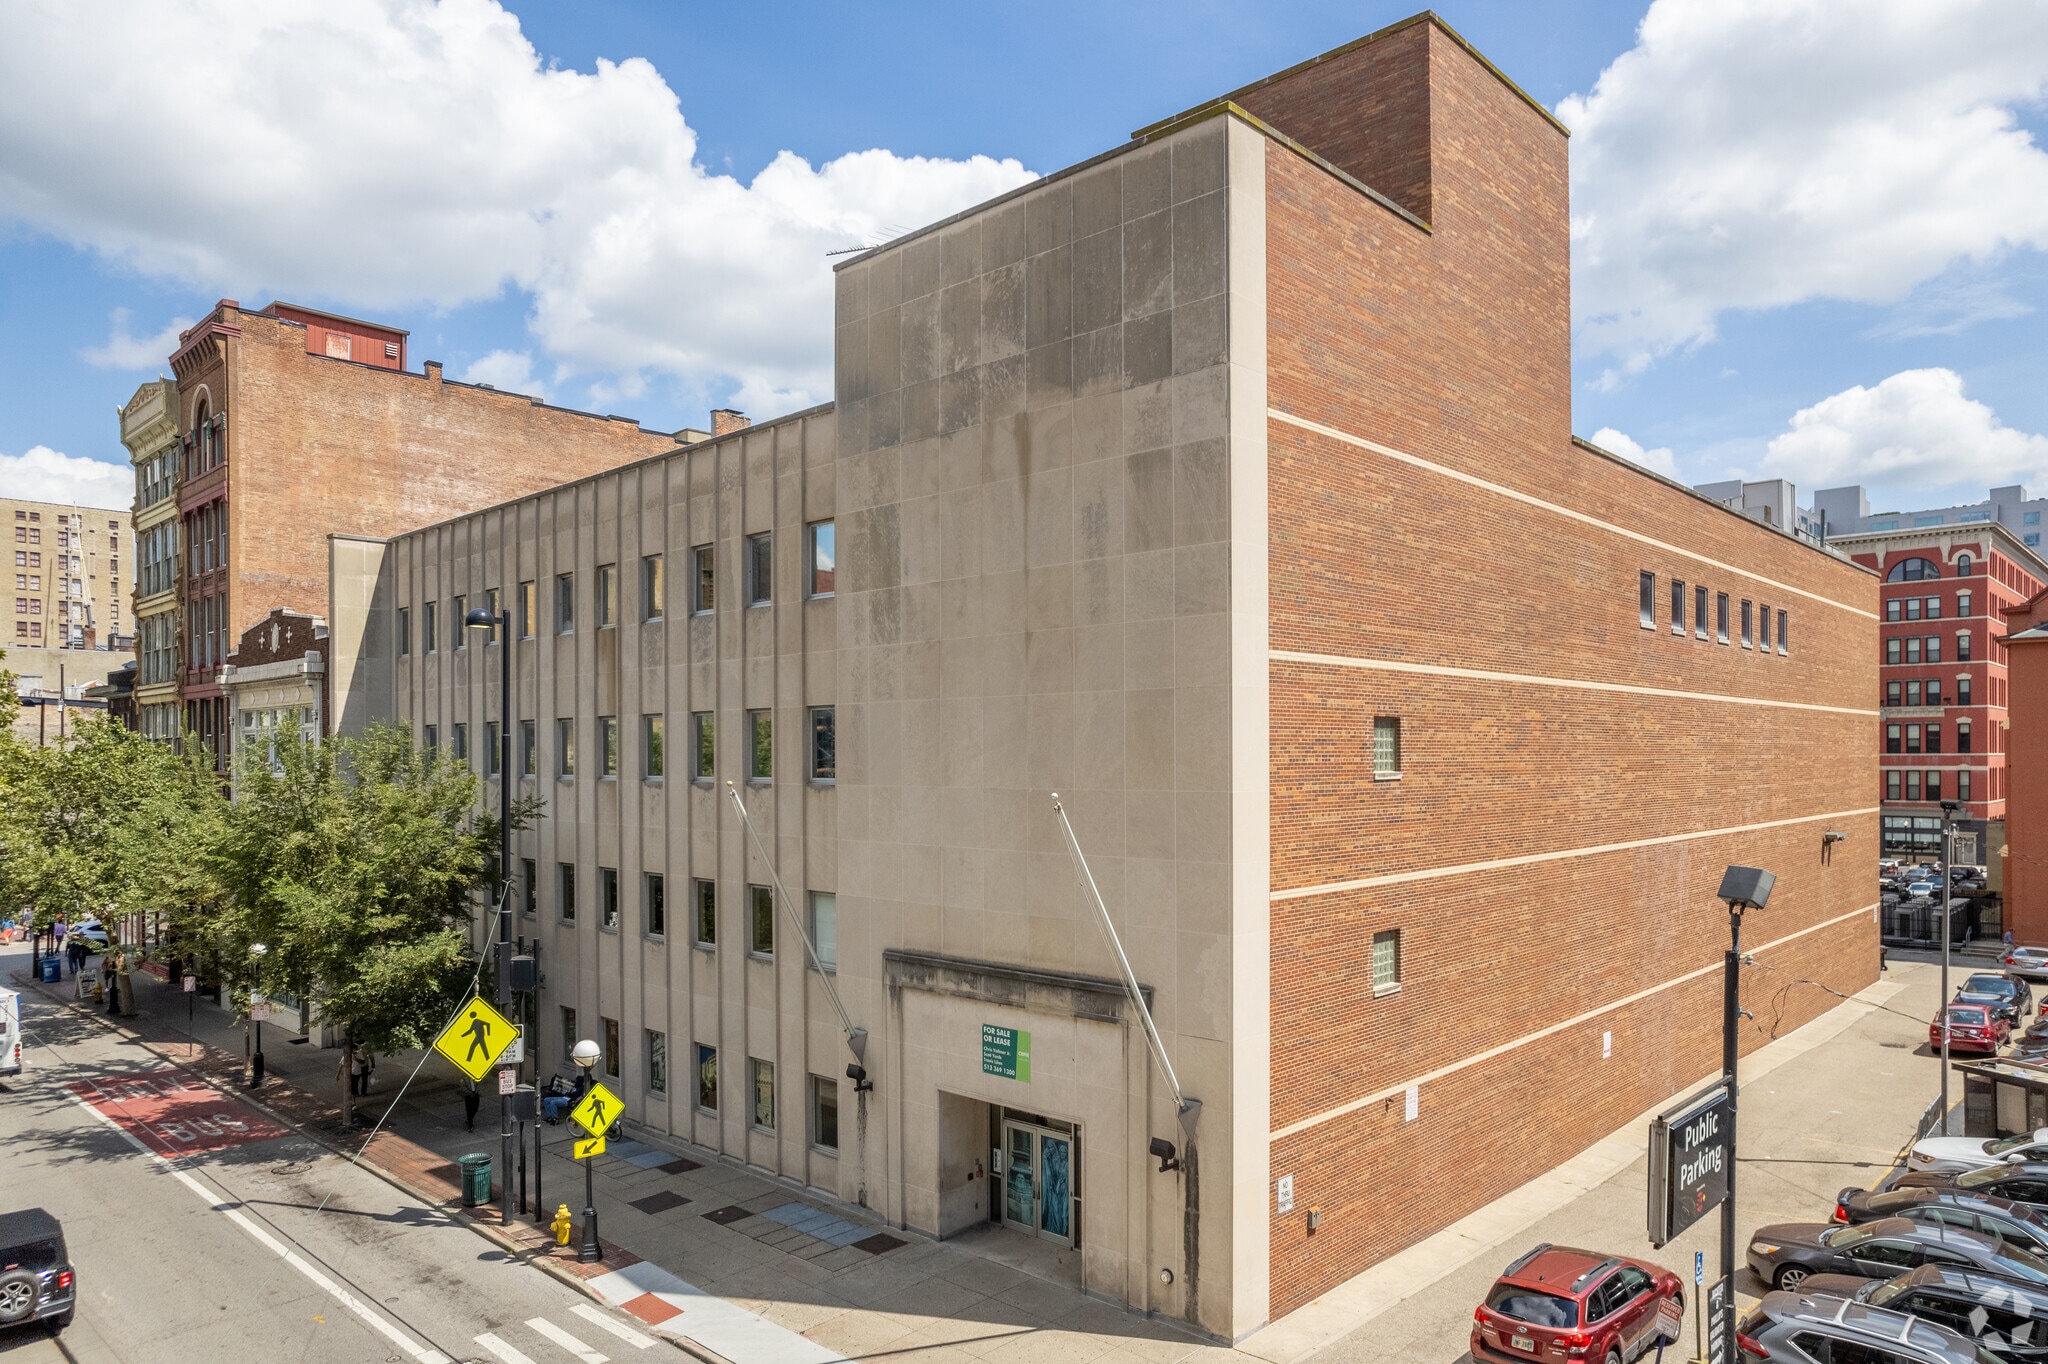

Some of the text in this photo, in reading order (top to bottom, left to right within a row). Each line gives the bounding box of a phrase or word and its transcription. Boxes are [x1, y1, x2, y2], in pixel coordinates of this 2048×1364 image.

[994, 1037, 1010, 1046] LEASE
[997, 1029, 1010, 1037] SALE
[97, 1076, 189, 1104] ONLY
[157, 1113, 250, 1142] BUS
[1685, 1110, 1719, 1152] Public
[1680, 1144, 1722, 1191] Parking
[1661, 1307, 1678, 1318] PARKING
[1662, 1301, 1680, 1313] RESERVED
